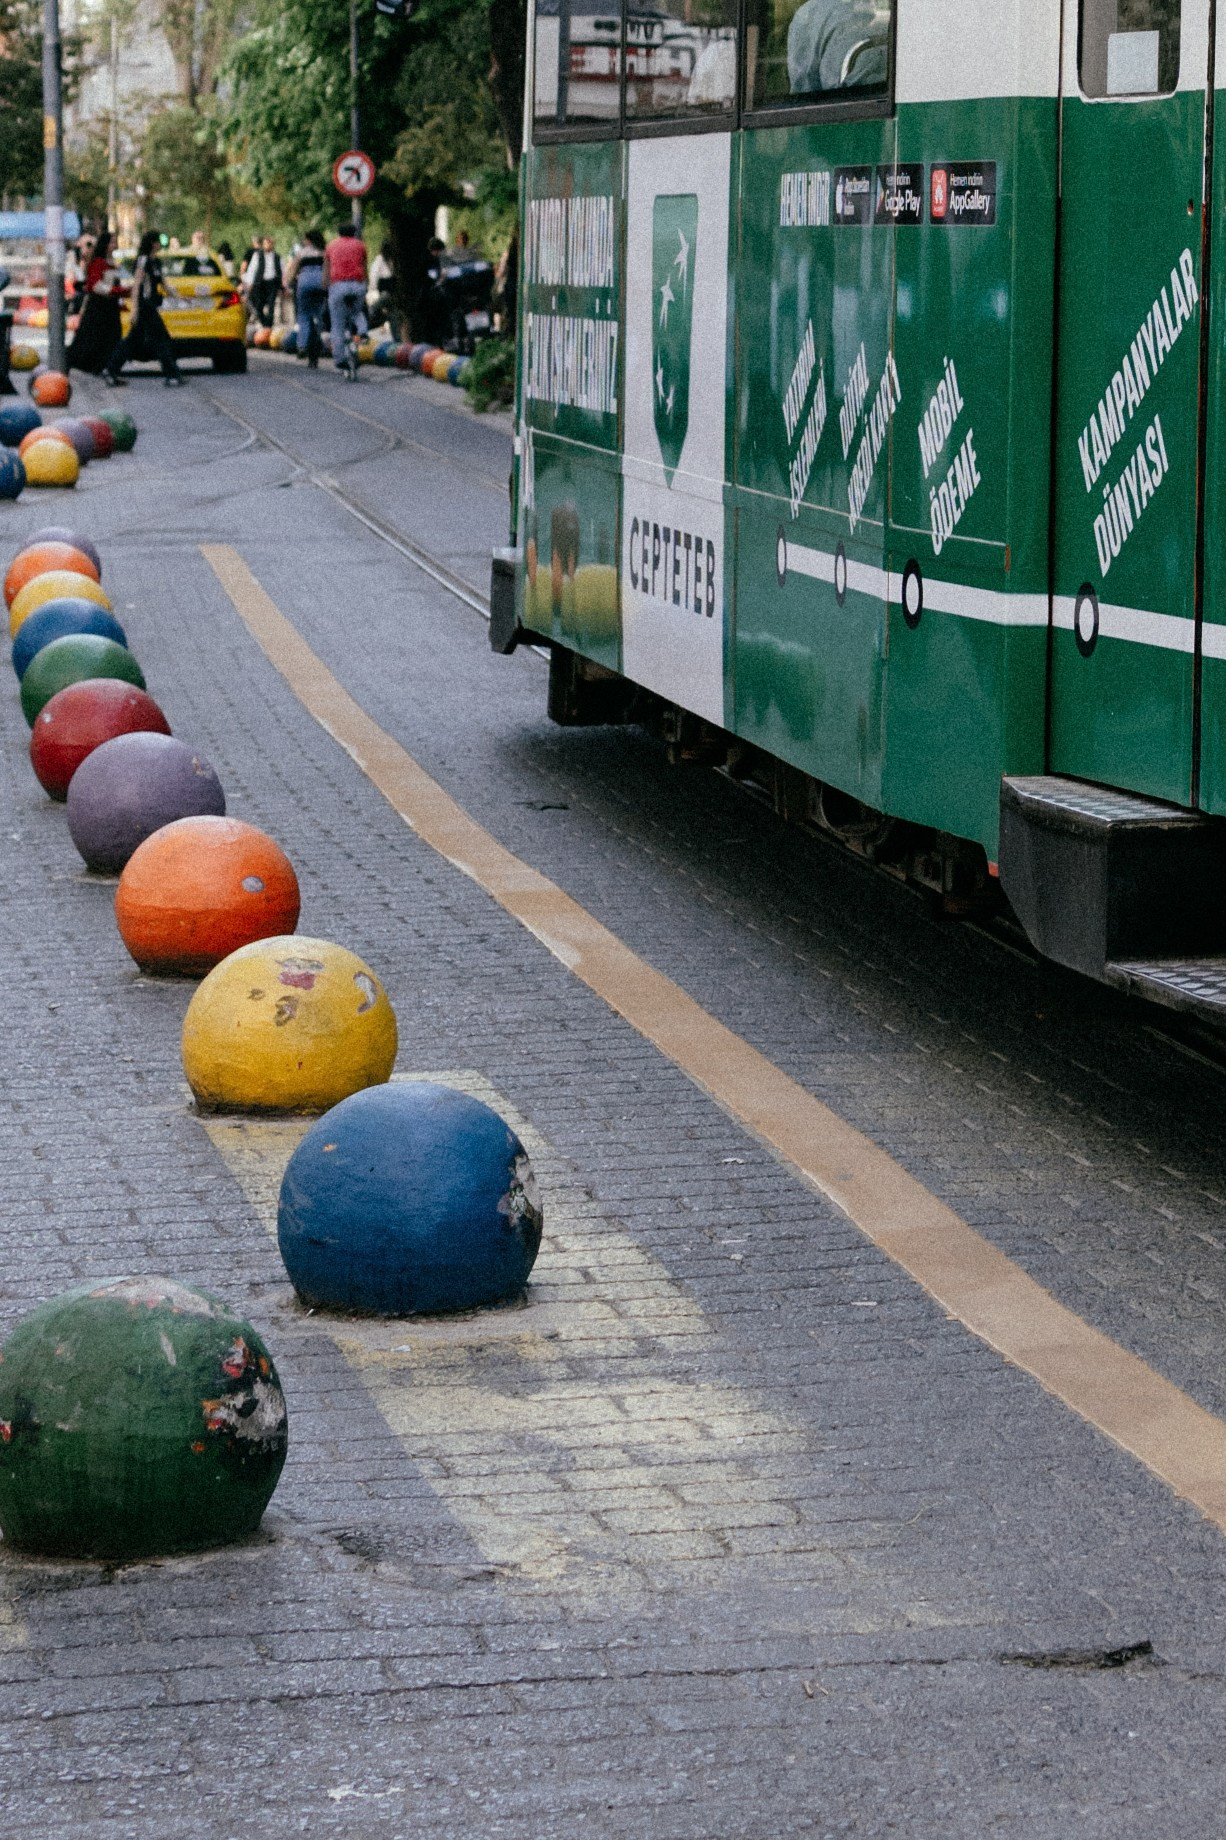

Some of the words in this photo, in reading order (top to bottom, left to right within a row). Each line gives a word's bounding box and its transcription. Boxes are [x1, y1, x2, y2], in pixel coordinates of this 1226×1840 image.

[885, 189, 905, 217] Google
[905, 189, 921, 217] Play
[949, 189, 991, 216] AppGallery
[917, 354, 964, 480] MOBİL
[1077, 247, 1199, 494] KAMPANYALAR
[847, 413, 874, 536] KREDİ
[929, 427, 982, 556] ÖDEME
[1093, 413, 1170, 579] DÜNYASI
[629, 515, 716, 619] CEPTETEB
